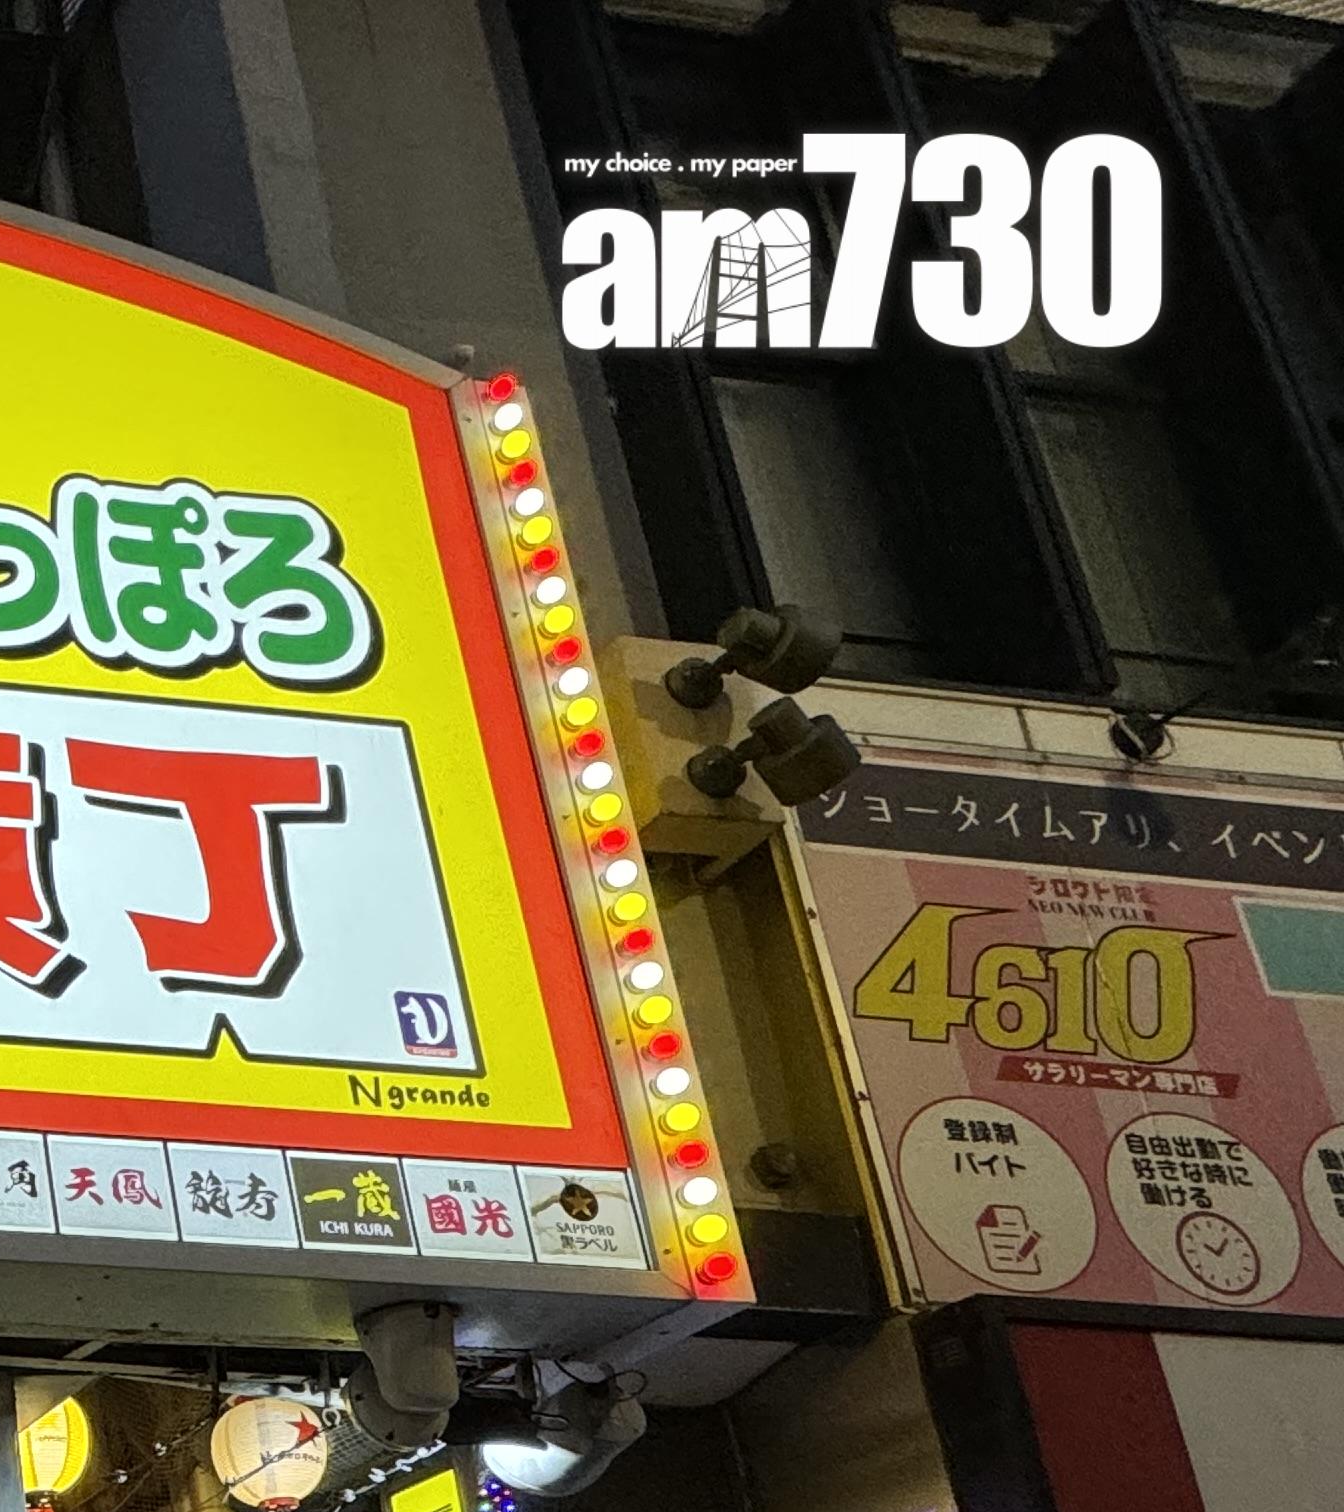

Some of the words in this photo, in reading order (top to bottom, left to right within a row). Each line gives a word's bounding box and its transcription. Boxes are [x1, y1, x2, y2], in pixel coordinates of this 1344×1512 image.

[819, 790, 1344, 864] ショータイムアリ、イベン
[854, 902, 1237, 1065] 4610
[1023, 1060, 1219, 1096] サラリーマン専門店
[944, 1119, 1018, 1146] 登録制
[1125, 1133, 1243, 1162] 自由出勤で
[953, 1153, 1027, 1178] バイト
[1132, 1158, 1253, 1188] 好きな時に
[65, 1167, 162, 1209] 天鳳
[304, 1169, 402, 1221] 一蔵
[1141, 1185, 1213, 1210] 働ける
[320, 1221, 349, 1235] ICHI
[353, 1222, 394, 1238] KURA
[556, 1222, 615, 1236] SAPPORO
[560, 1235, 618, 1252] 黒ラベル
